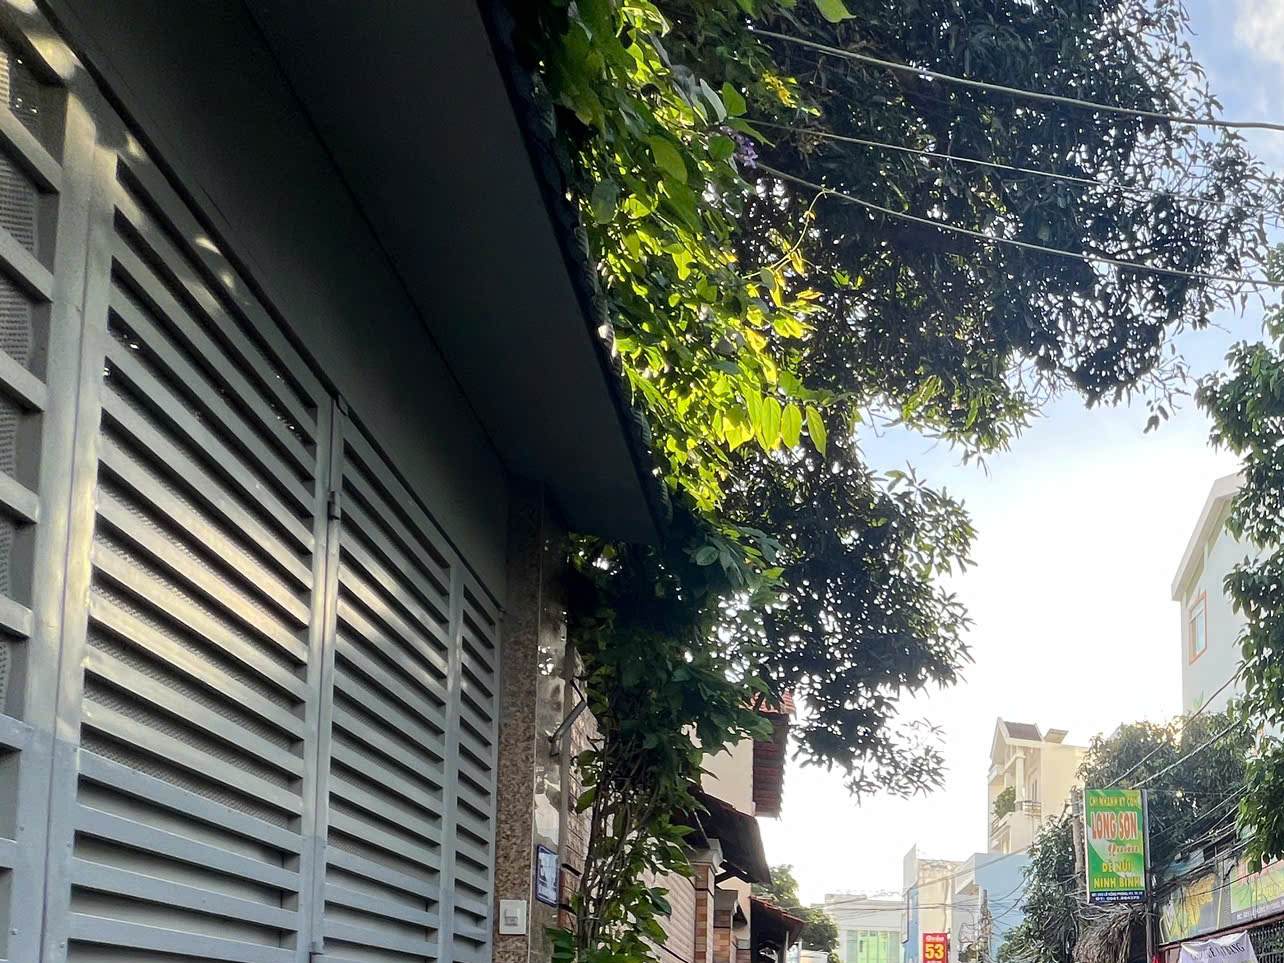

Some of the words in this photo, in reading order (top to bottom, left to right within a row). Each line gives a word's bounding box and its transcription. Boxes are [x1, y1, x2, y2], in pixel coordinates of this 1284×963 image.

[1091, 811, 1117, 840] LONG
[1094, 877, 1116, 888] NINH
[925, 943, 944, 960] 53
